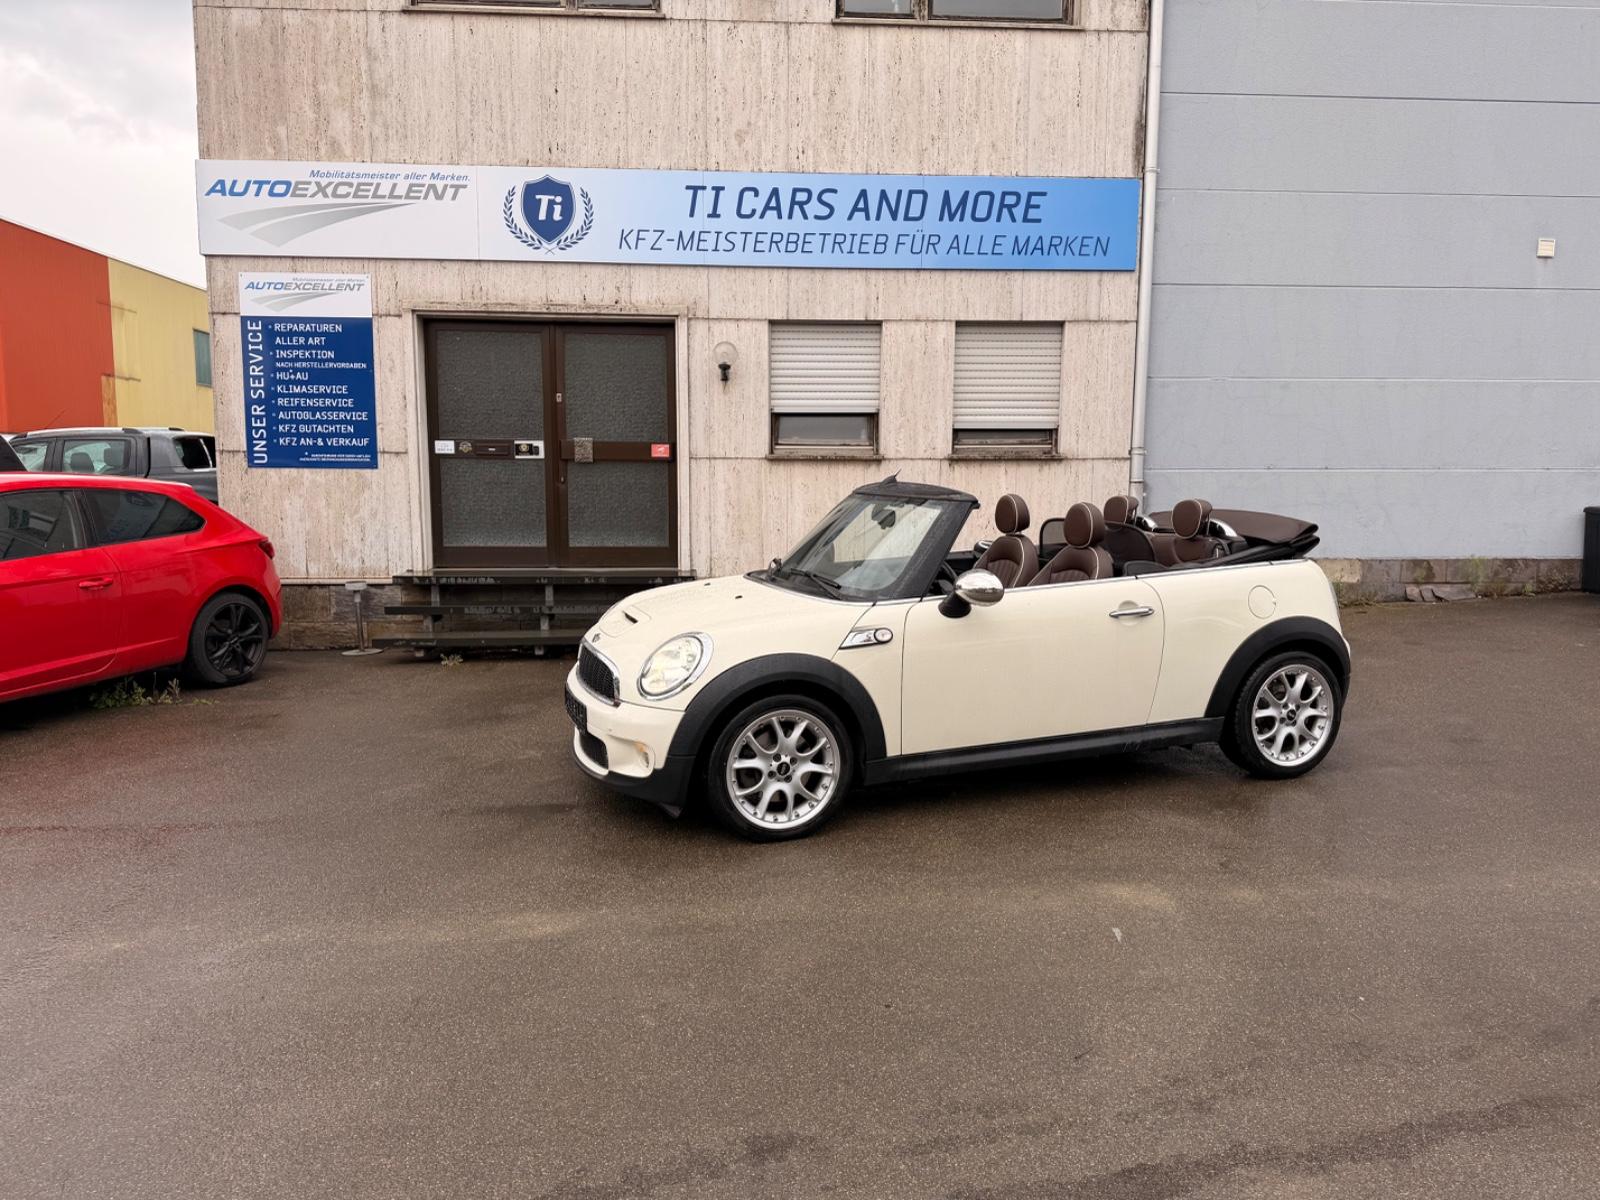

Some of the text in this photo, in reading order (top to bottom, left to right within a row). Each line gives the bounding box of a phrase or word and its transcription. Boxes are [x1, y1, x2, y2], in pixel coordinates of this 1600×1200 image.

[403, 172, 427, 182] aller
[429, 172, 470, 182] Marken.
[205, 178, 468, 201] AUTOEXCELLENT
[535, 194, 563, 221] Ti
[685, 185, 1048, 223] TI CARS AND MORE
[619, 229, 1110, 257] KFZ-MEISTERBETRIEB FÜR ALLE MARKEN
[244, 281, 365, 292] AUTOEXCELLENT
[274, 323, 342, 333] REPARATUREN
[275, 337, 326, 346] ALLER ART
[275, 349, 335, 359] INSPEKTION
[247, 320, 268, 464] UNSER SERVICE
[277, 385, 348, 394] KLIMASERVICE
[277, 398, 354, 407] REIFENSERVICE
[278, 411, 368, 420] AUTOGLASSERVICE
[278, 424, 354, 433] KFZ GUTACHTEN
[279, 437, 297, 446] KFZ
[327, 437, 370, 447] VERKAUF
